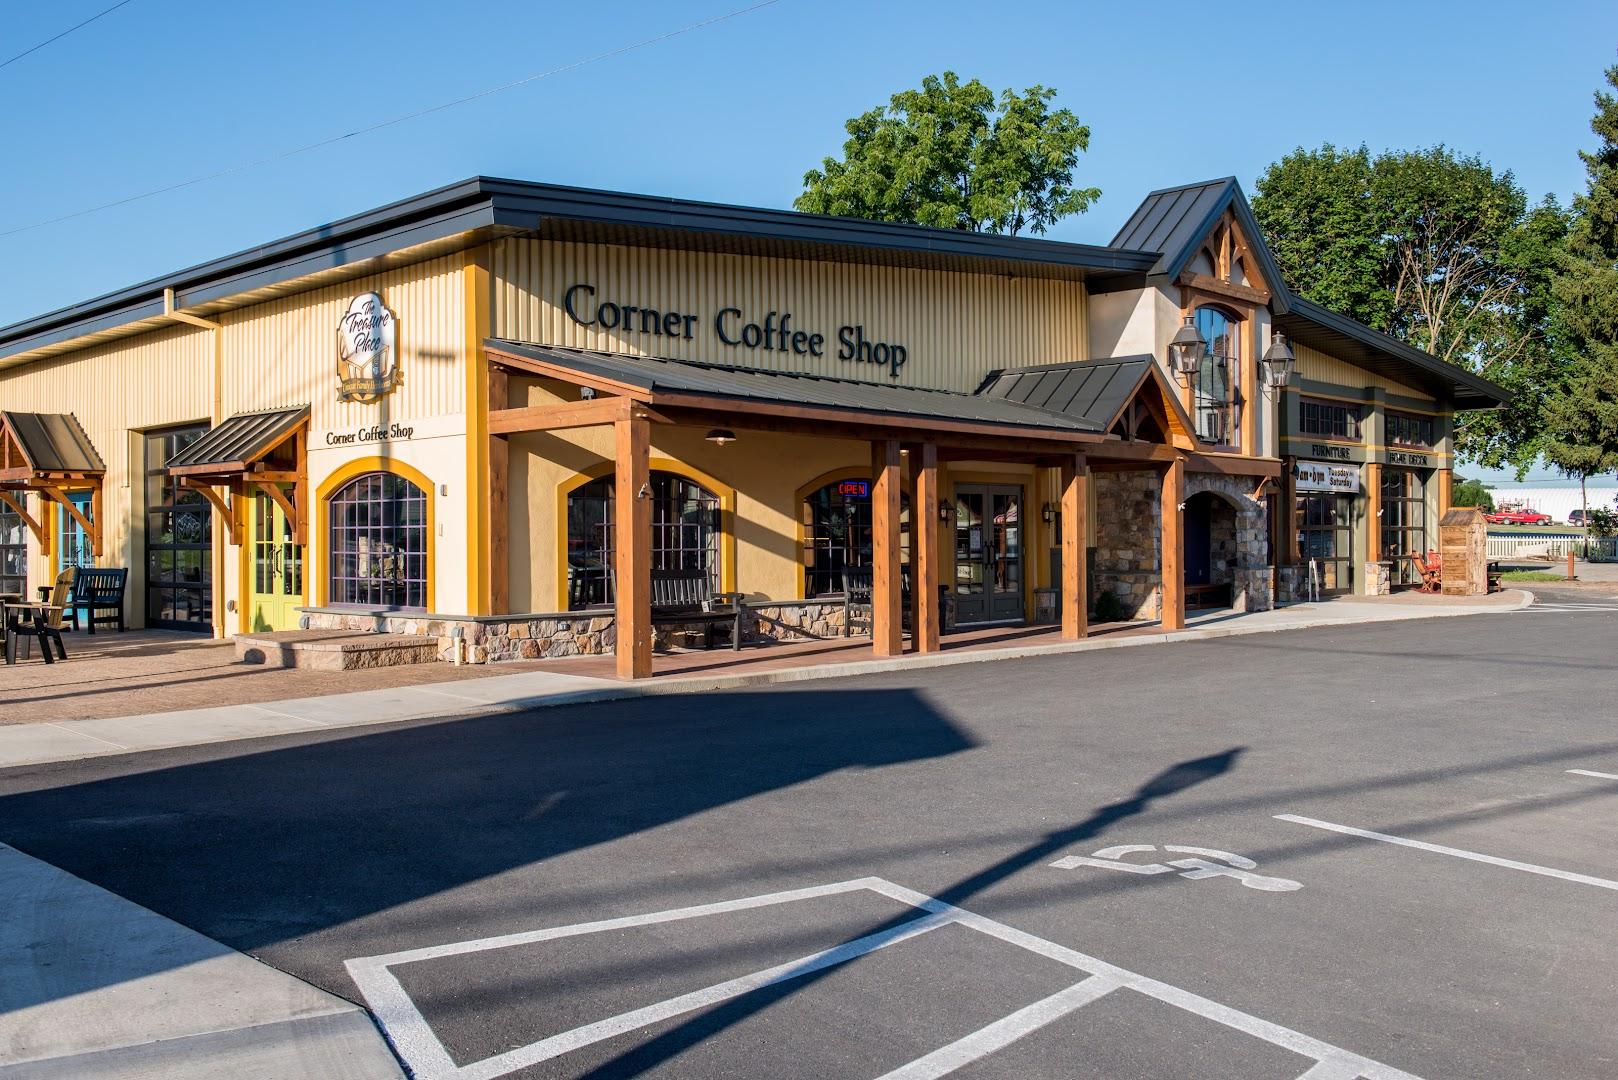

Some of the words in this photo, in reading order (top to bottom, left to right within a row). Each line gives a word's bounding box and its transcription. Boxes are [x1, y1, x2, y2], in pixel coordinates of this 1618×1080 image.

[362, 300, 376, 316] The
[346, 312, 389, 333] Treasure
[565, 284, 698, 339] Corner
[716, 307, 825, 357] Coffee
[838, 324, 907, 377] Shop
[354, 331, 381, 354] Place
[326, 431, 356, 446] Corner
[358, 426, 388, 442] Coffee
[391, 423, 414, 440] Shop
[1312, 444, 1351, 460] FURNITURE
[1389, 452, 1407, 465] HOME
[1409, 453, 1428, 466] DECOR
[1328, 466, 1349, 479] Tuesday
[839, 483, 866, 495] OPEN
[1330, 476, 1352, 488] Saturday
